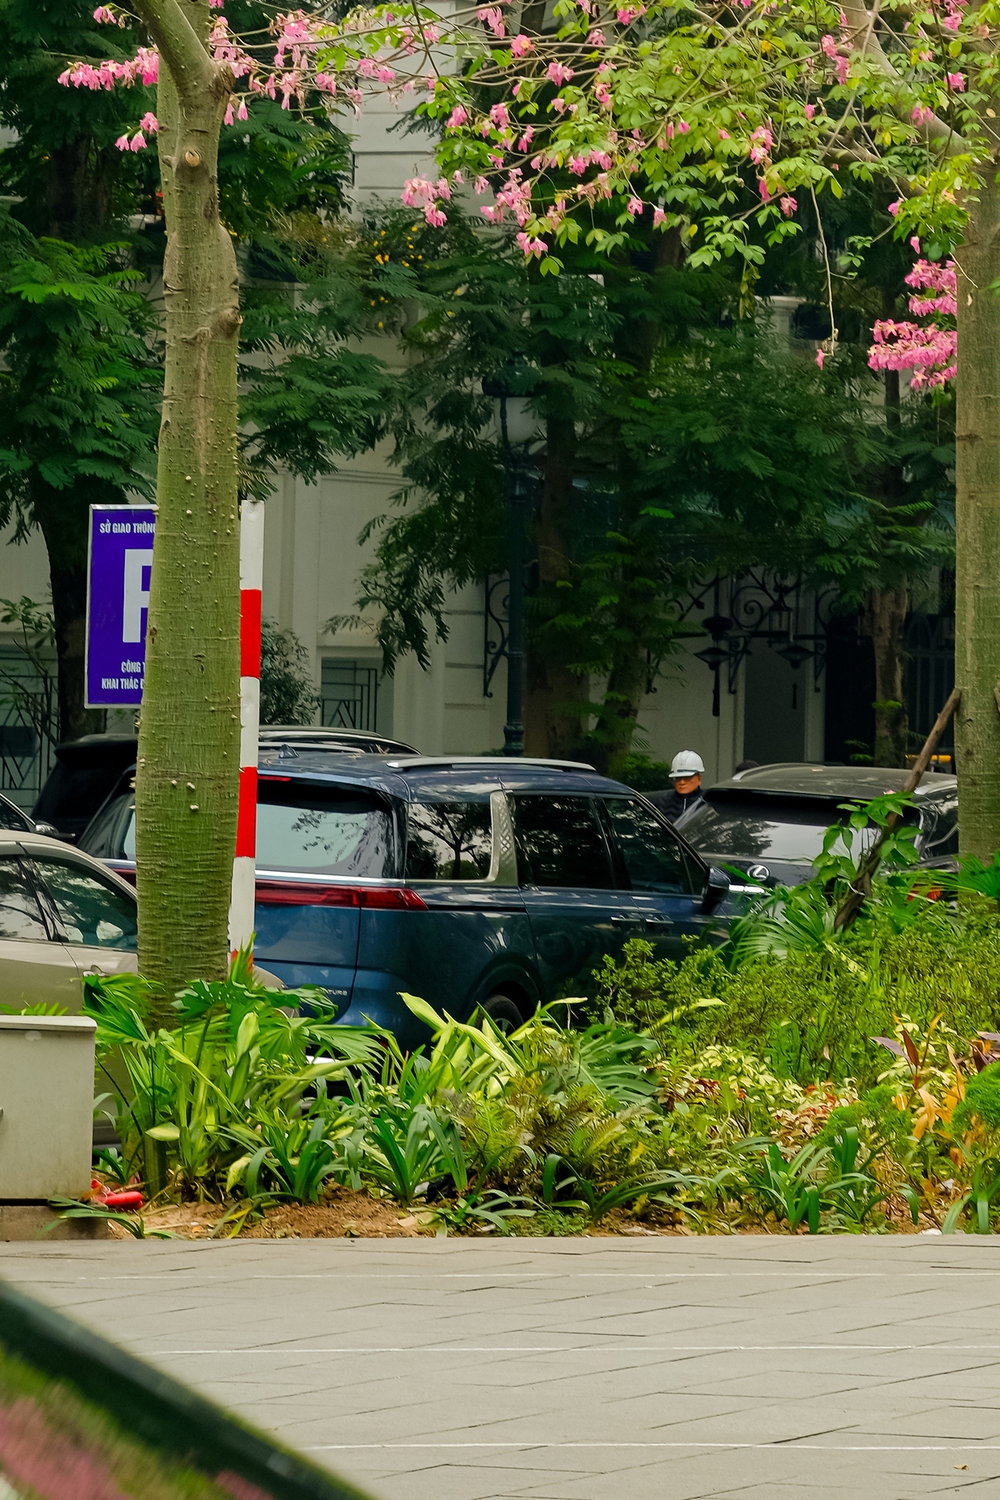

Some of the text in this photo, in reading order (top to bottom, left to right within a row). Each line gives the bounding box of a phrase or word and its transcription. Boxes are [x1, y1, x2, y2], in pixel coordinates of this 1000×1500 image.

[99, 519, 111, 533] SỞ
[112, 522, 131, 534] GIAO
[121, 659, 141, 673] CÔNG
[101, 677, 119, 690] KHAI
[120, 676, 139, 690] THÁC
